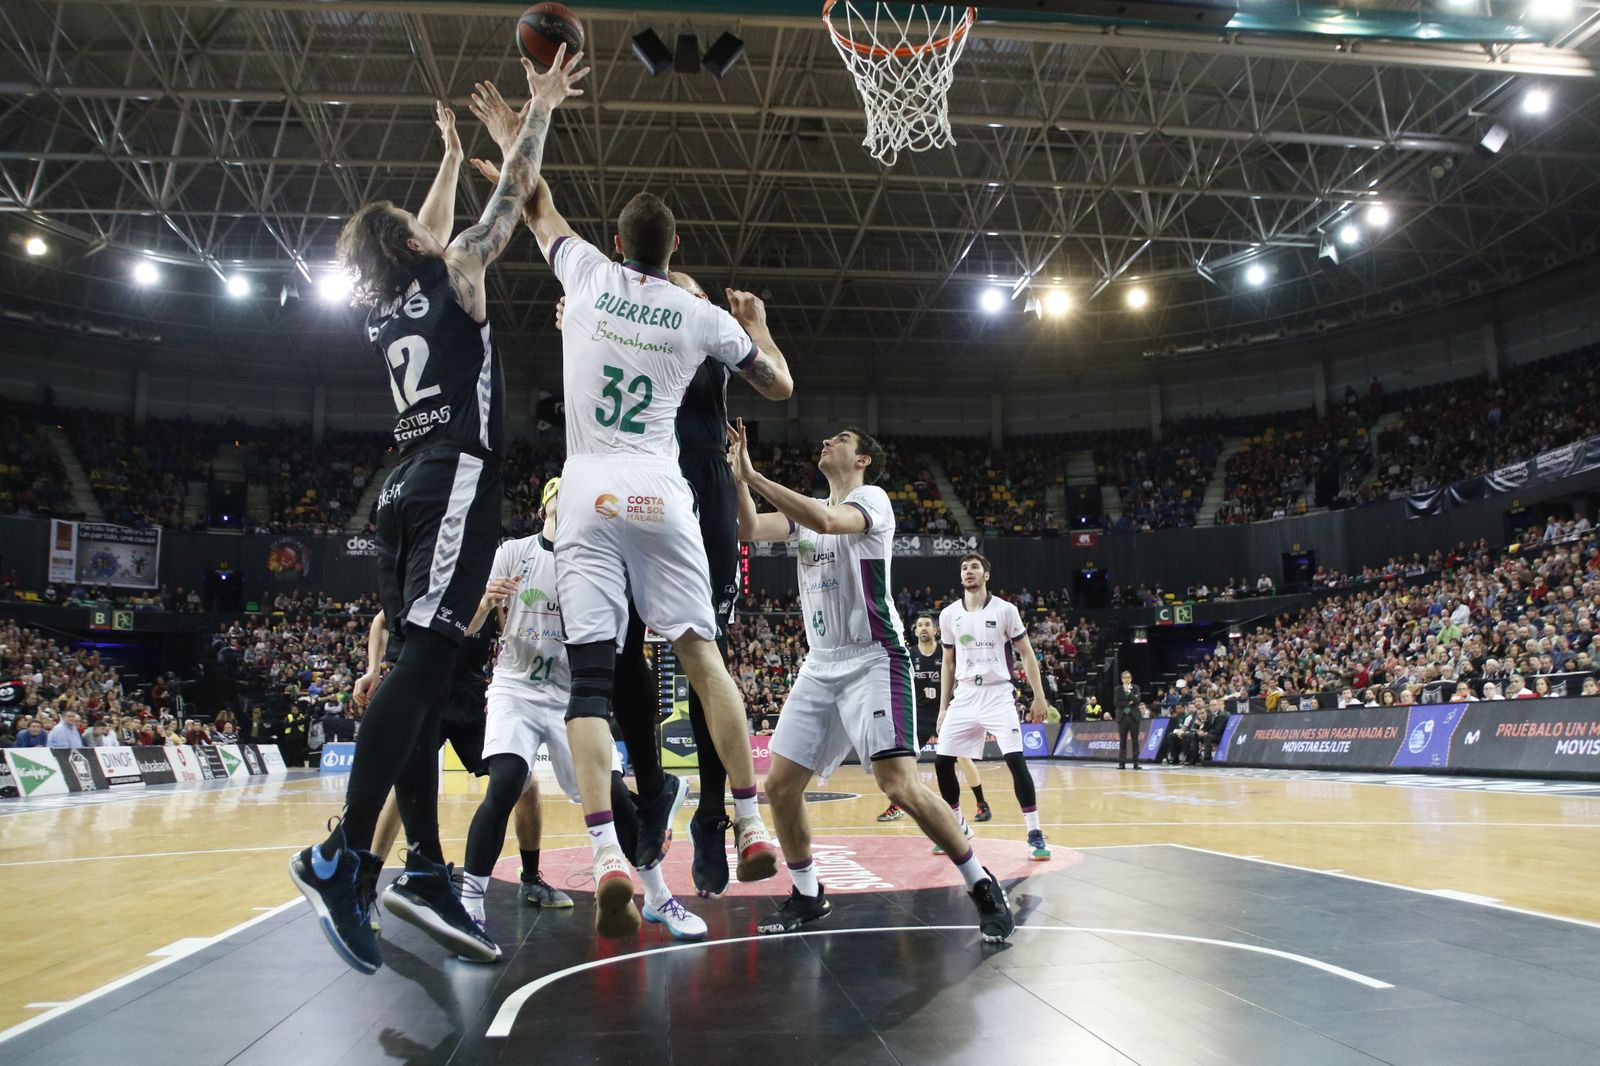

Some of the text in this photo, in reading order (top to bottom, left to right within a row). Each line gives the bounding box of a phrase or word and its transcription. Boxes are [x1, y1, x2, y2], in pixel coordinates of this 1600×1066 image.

[594, 292, 682, 330] GUERRERO
[595, 364, 653, 435] 32
[627, 495, 664, 506] COSTA
[627, 506, 665, 515] DEL SOL
[346, 535, 377, 550] dos
[95, 612, 105, 624] B
[1159, 609, 1169, 620] C
[529, 655, 554, 681] 21
[923, 687, 937, 699] 10
[1289, 729, 1300, 739] UN
[1300, 729, 1316, 739] MES
[1316, 728, 1330, 739] SIN
[1330, 727, 1358, 740] PAGAR
[1359, 727, 1383, 739] NADA
[1384, 727, 1399, 738] EN
[1495, 720, 1564, 737] PRUÉBALO
[1565, 722, 1588, 737] UN
[1281, 741, 1351, 753] MOVISTAR.ES/LITE
[1554, 740, 1600, 755] MOVIS
